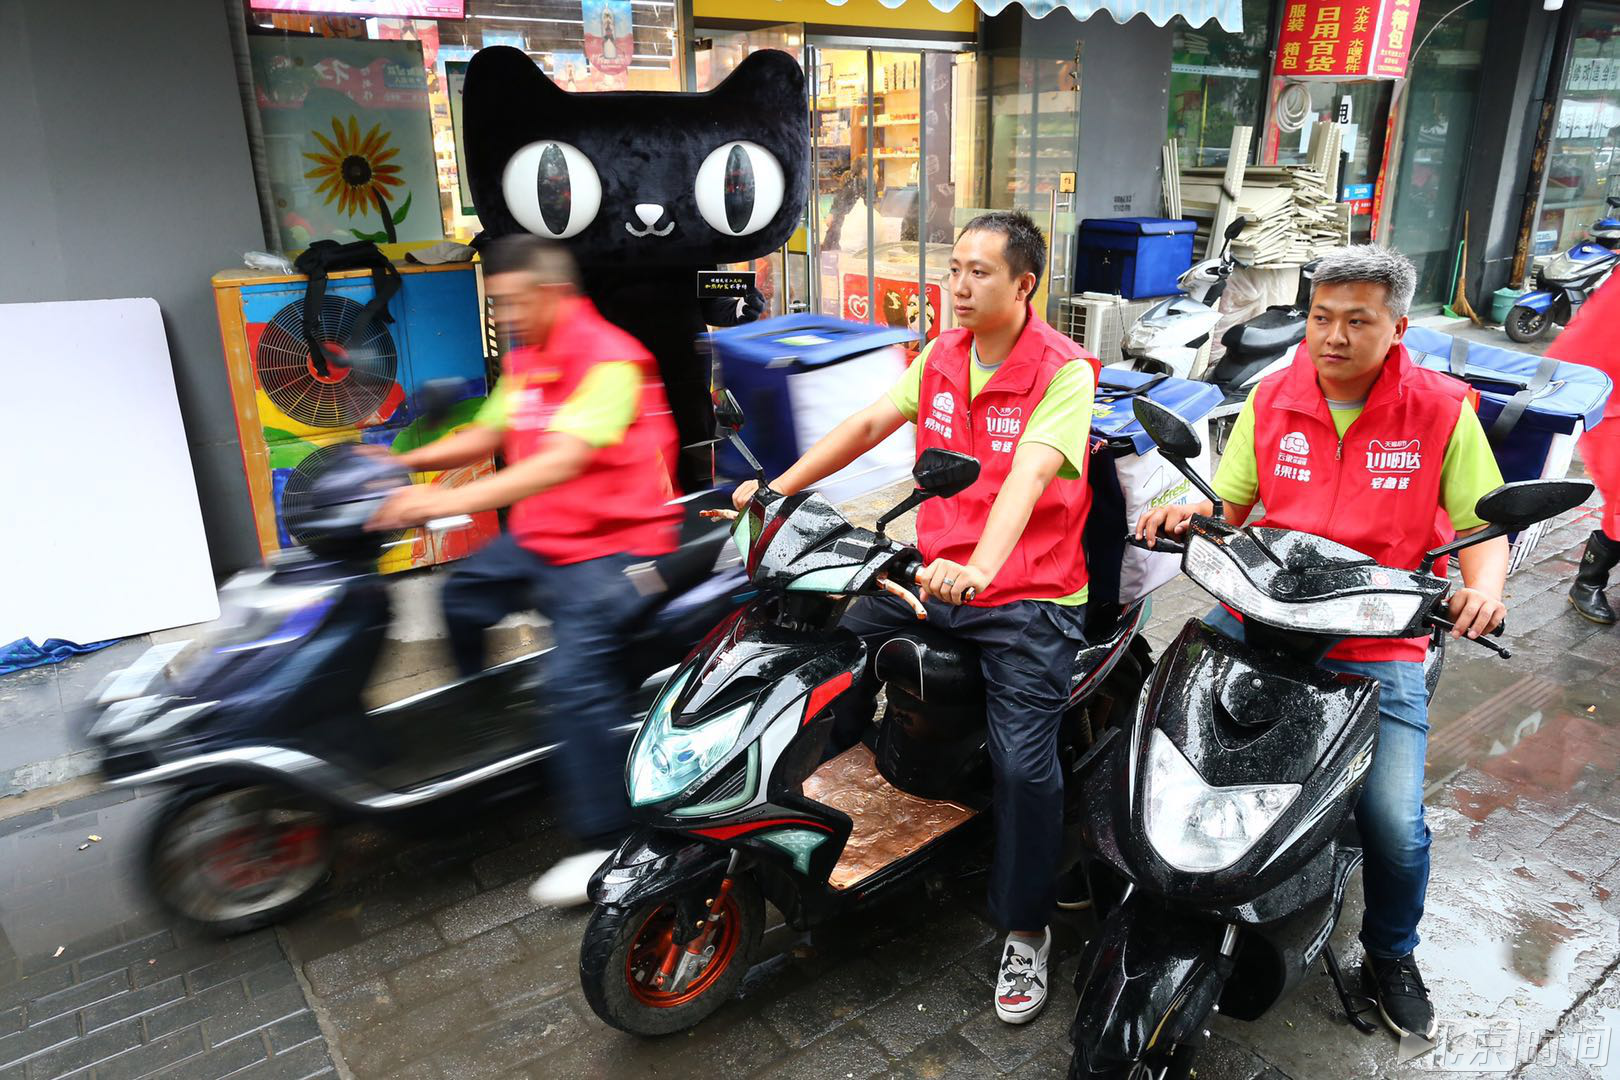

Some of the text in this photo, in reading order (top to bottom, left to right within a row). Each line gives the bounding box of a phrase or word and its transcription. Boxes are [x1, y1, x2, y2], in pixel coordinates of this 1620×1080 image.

[1281, 4, 1308, 70] 服装 箱包
[1305, 6, 1342, 73] 日用百货
[1345, 6, 1371, 73] 水龙头 水暖配件
[1365, 451, 1422, 469] 1小时达
[1370, 476, 1411, 490] 宅急送
